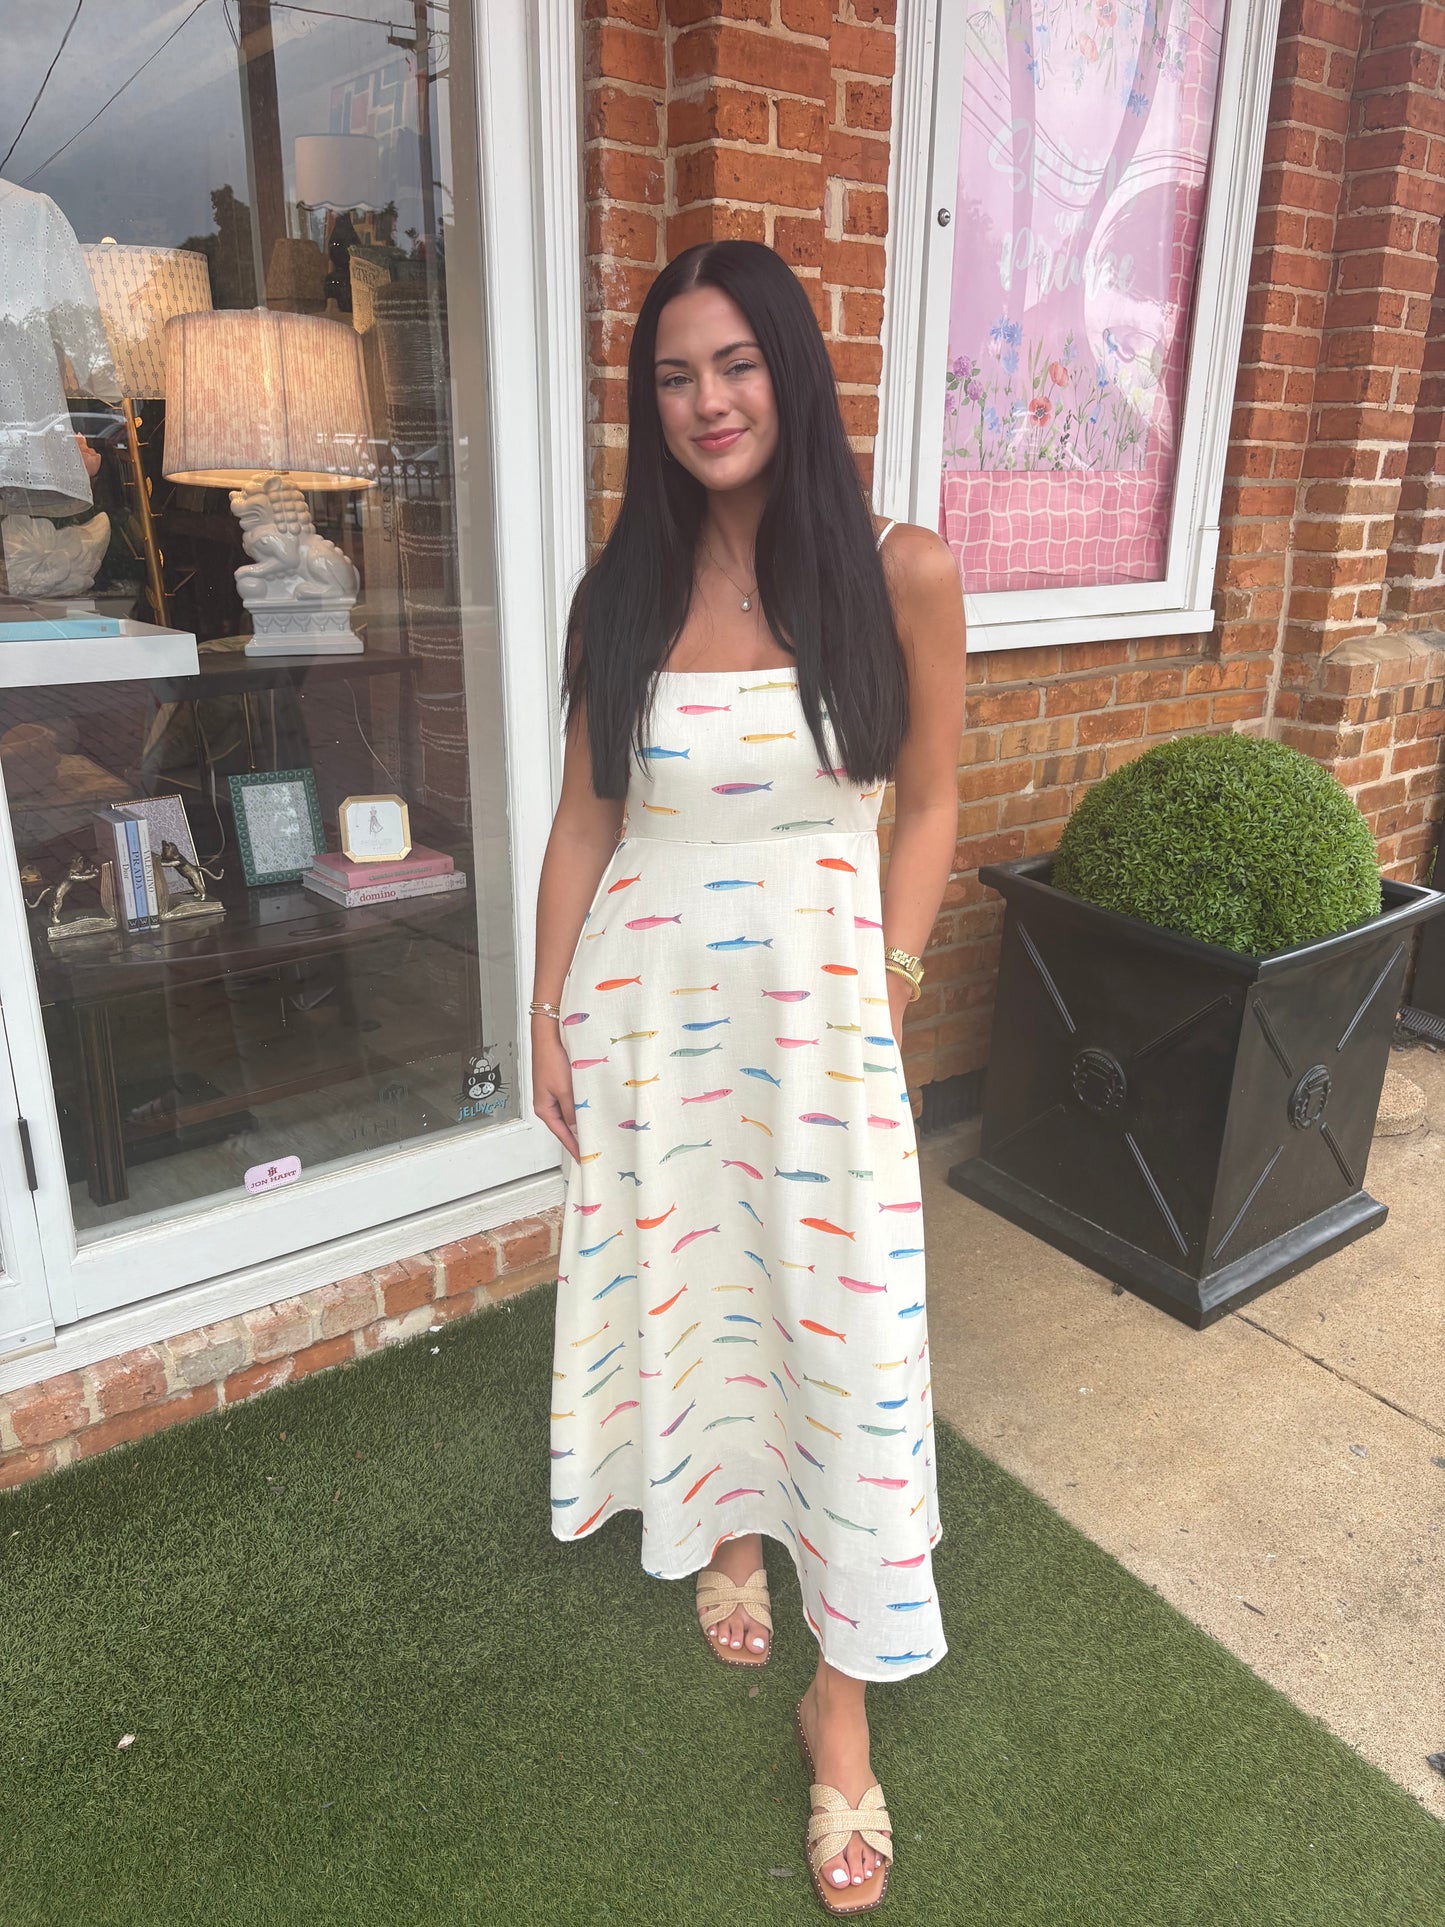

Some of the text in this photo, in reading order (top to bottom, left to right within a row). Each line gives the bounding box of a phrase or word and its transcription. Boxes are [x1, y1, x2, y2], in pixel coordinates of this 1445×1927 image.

[988, 117, 1142, 213] Spring
[132, 851, 143, 890] PRADA
[143, 850, 155, 893] VALENTINO
[359, 889, 396, 902] domino
[251, 1170, 296, 1188] JON HART
